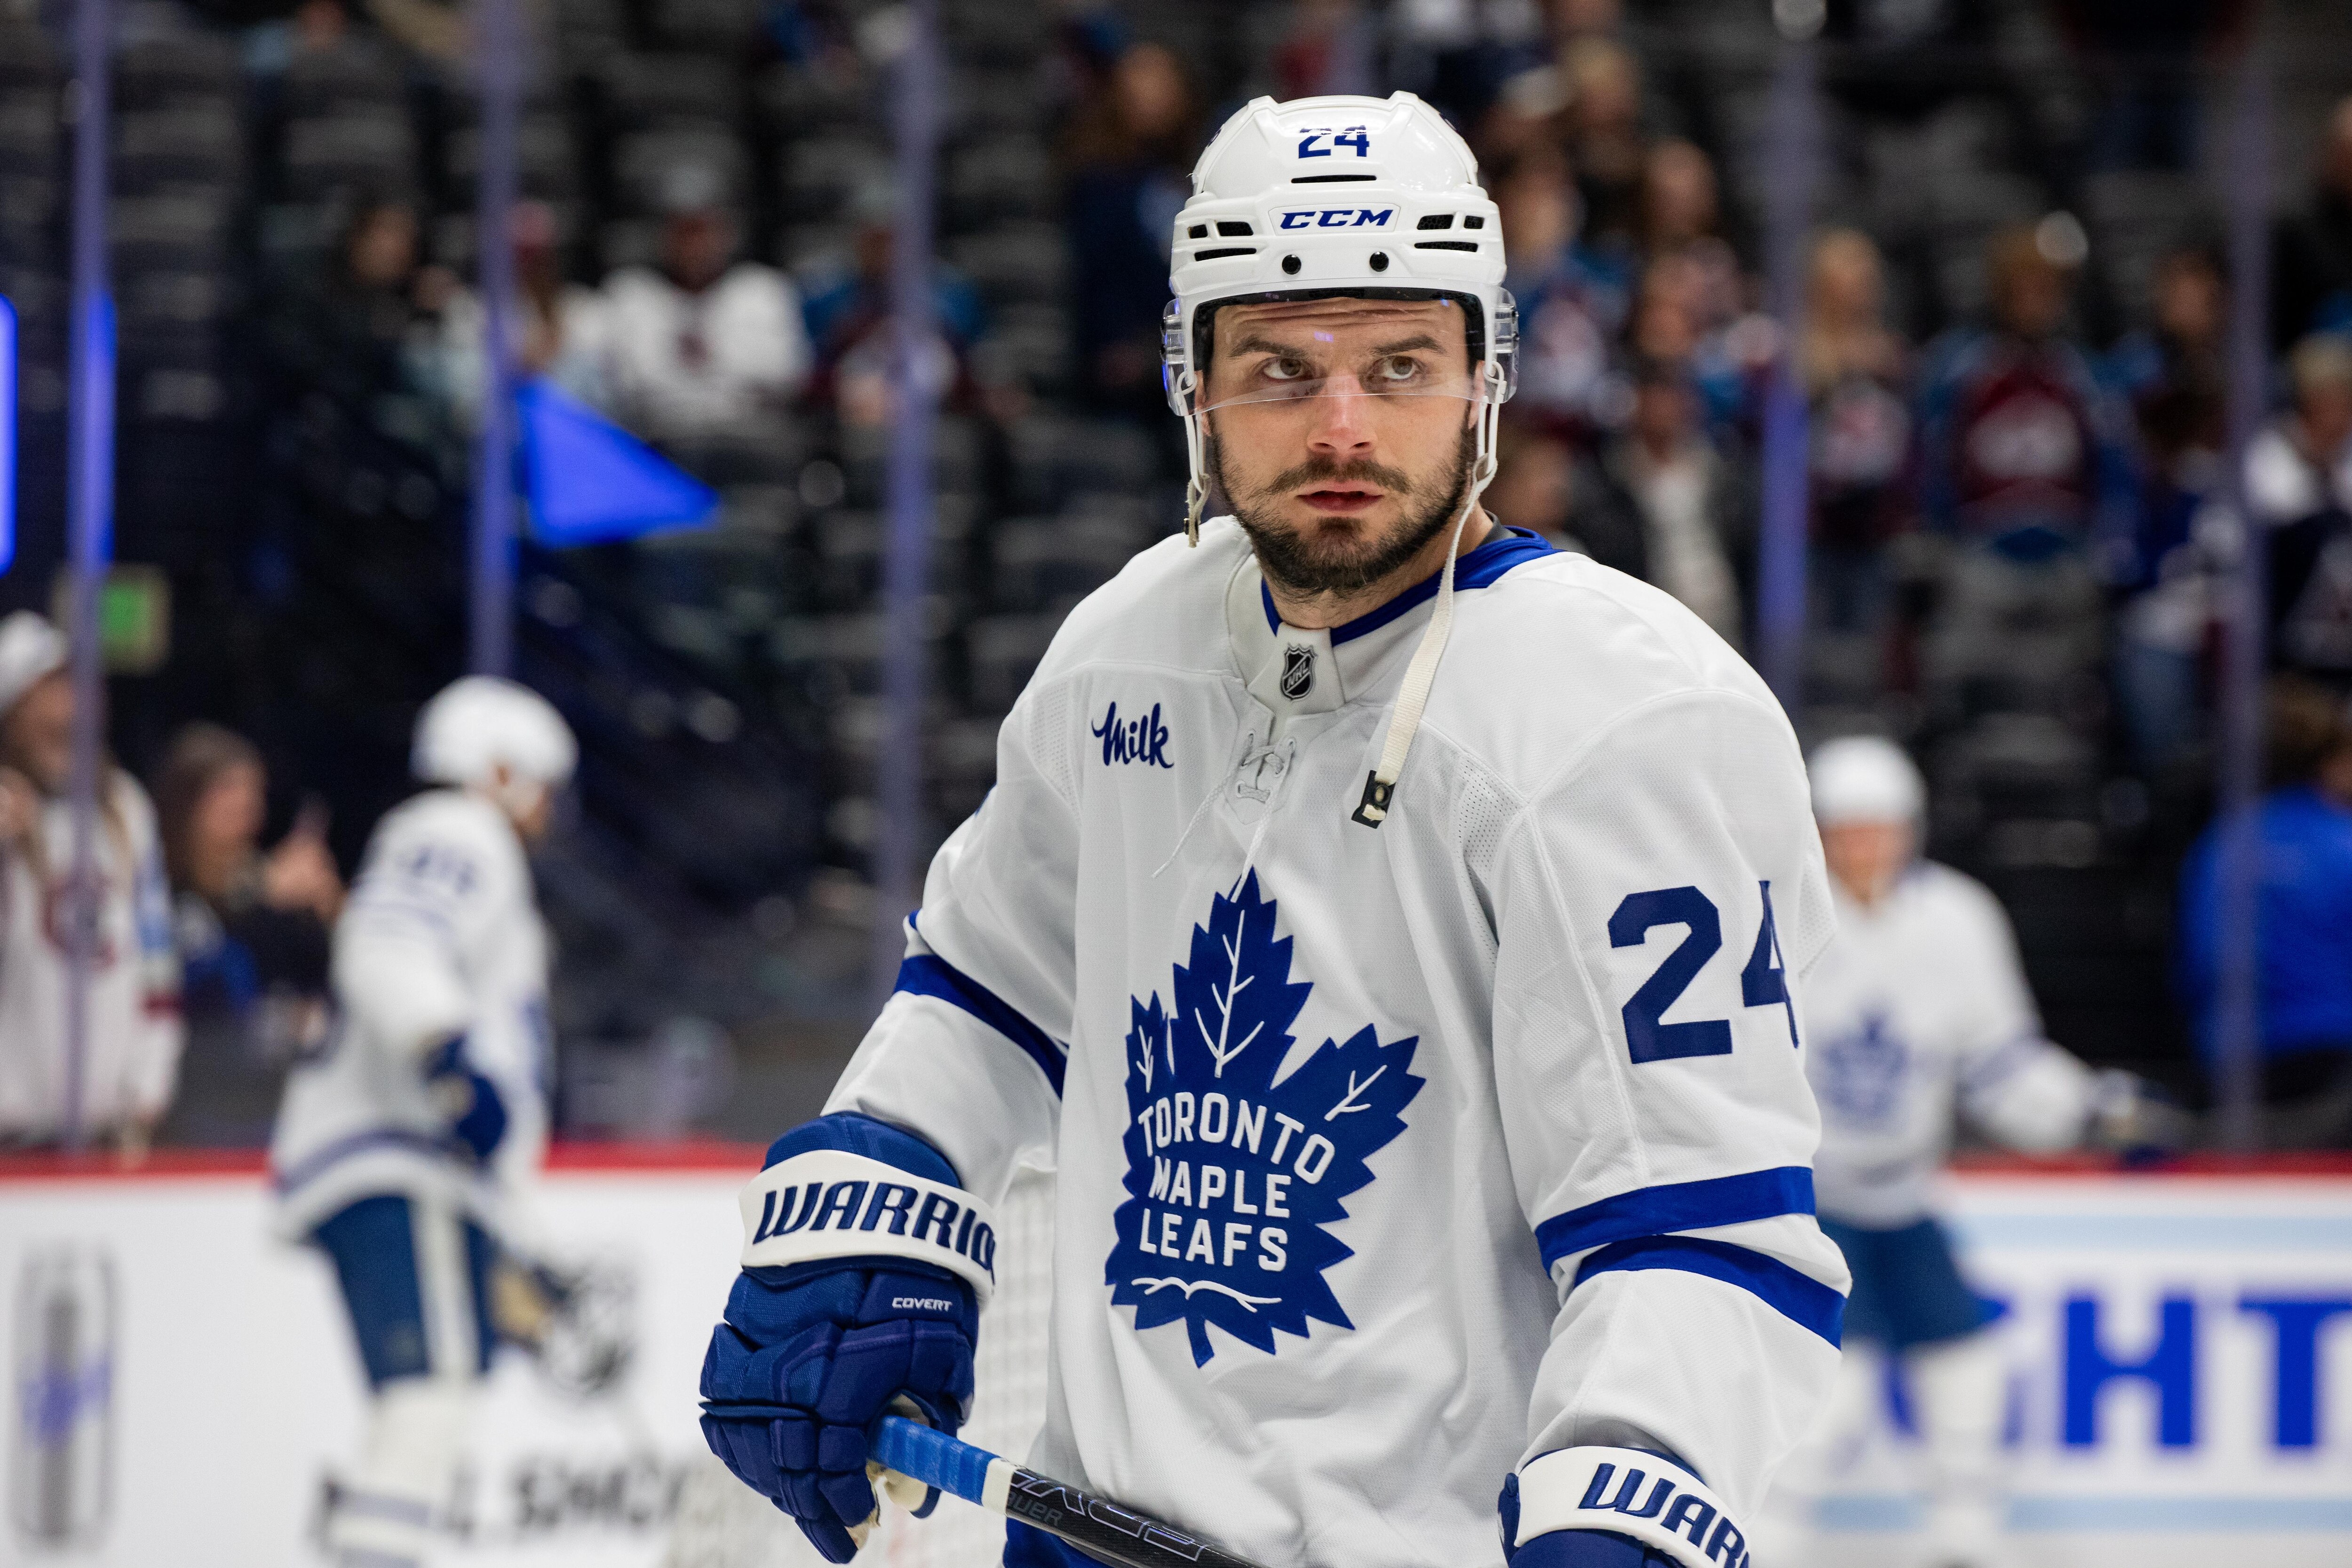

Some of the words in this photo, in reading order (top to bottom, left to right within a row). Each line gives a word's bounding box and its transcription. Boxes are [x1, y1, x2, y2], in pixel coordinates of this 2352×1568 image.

[1298, 125, 1370, 158] 24
[1280, 210, 1393, 230] CCM
[1287, 661, 1309, 689] NHL
[1092, 701, 1174, 768] Milk
[1608, 880, 1799, 1064] 24
[1138, 1092, 1335, 1184] TORONTO
[1149, 1155, 1291, 1219] MAPLE
[753, 1180, 996, 1286] WARRIO
[1139, 1208, 1287, 1271] LEAFS
[892, 1298, 953, 1312] COVERT
[1578, 1463, 1750, 1568] WAR
